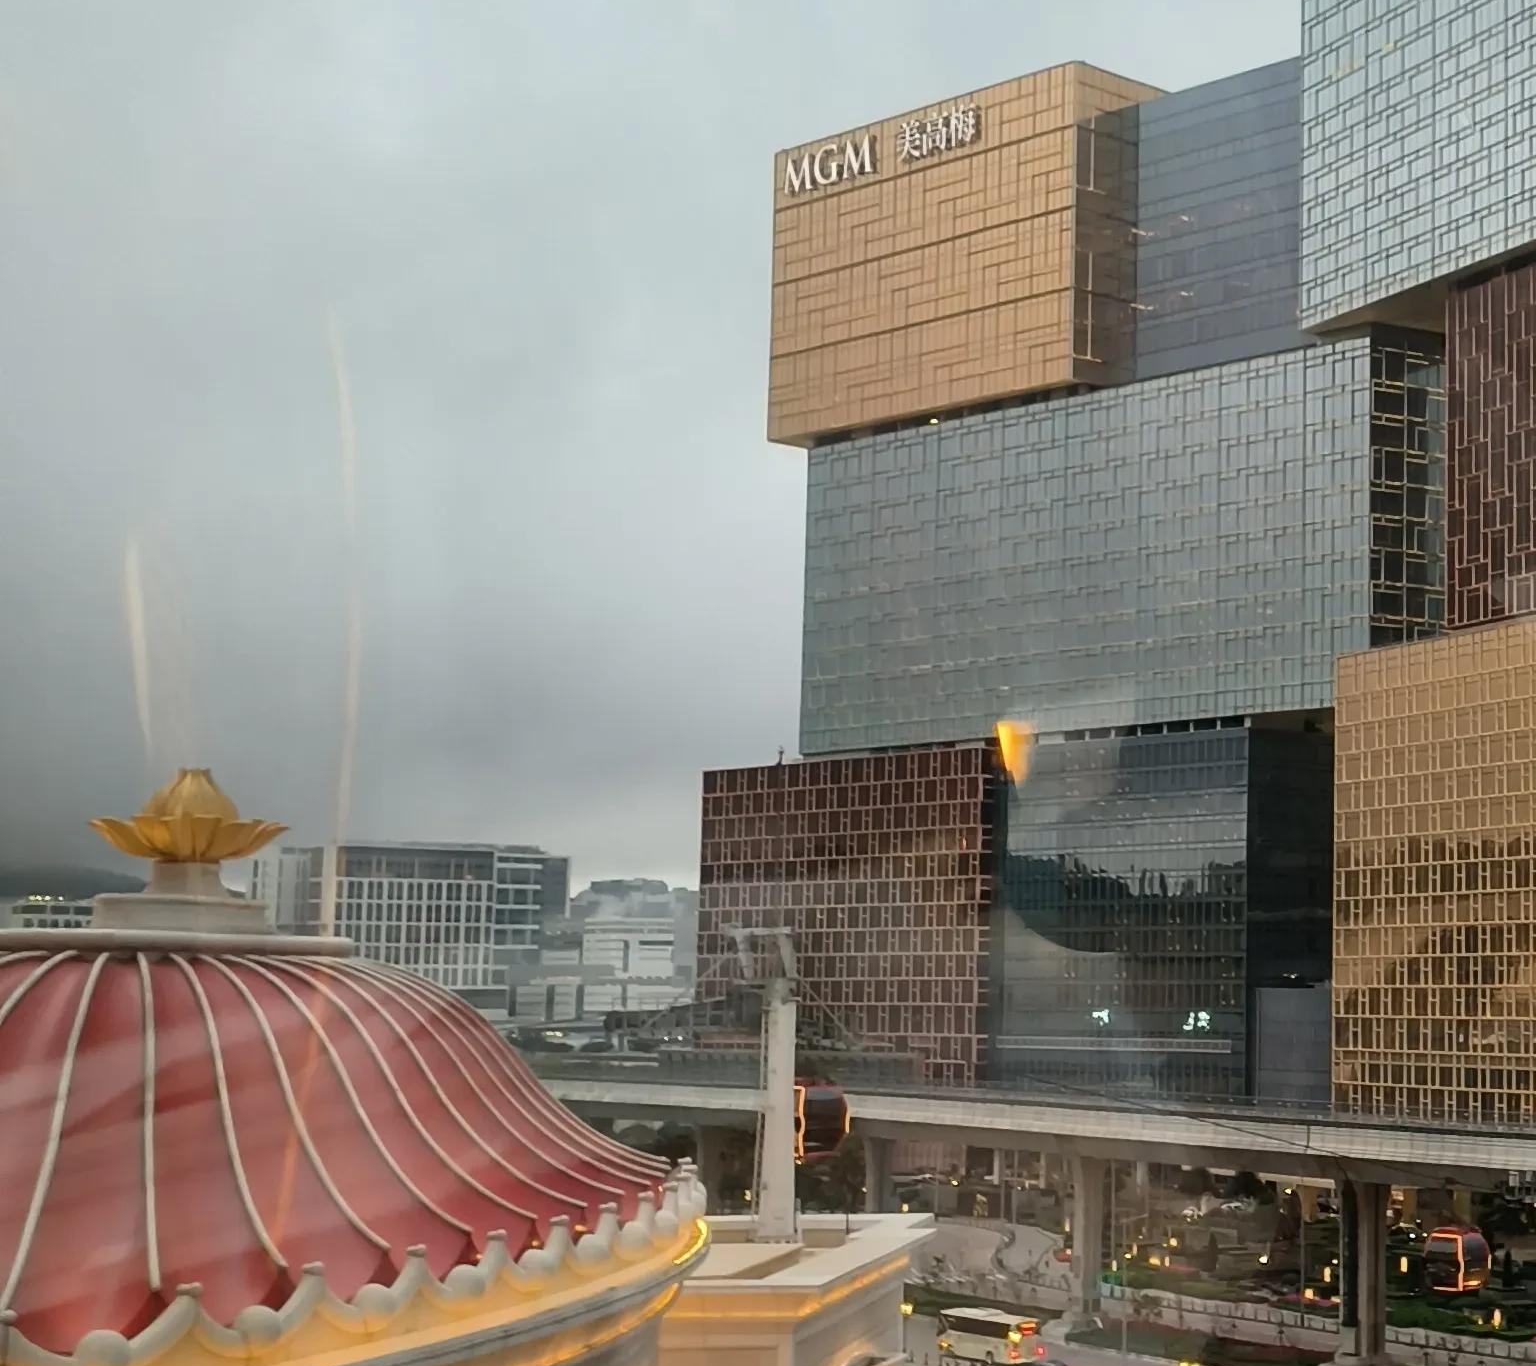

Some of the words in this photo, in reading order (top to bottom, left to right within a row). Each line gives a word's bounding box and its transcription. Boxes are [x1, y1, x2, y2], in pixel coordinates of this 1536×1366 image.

[784, 134, 874, 194] MGM
[900, 103, 977, 162] 美高梅
